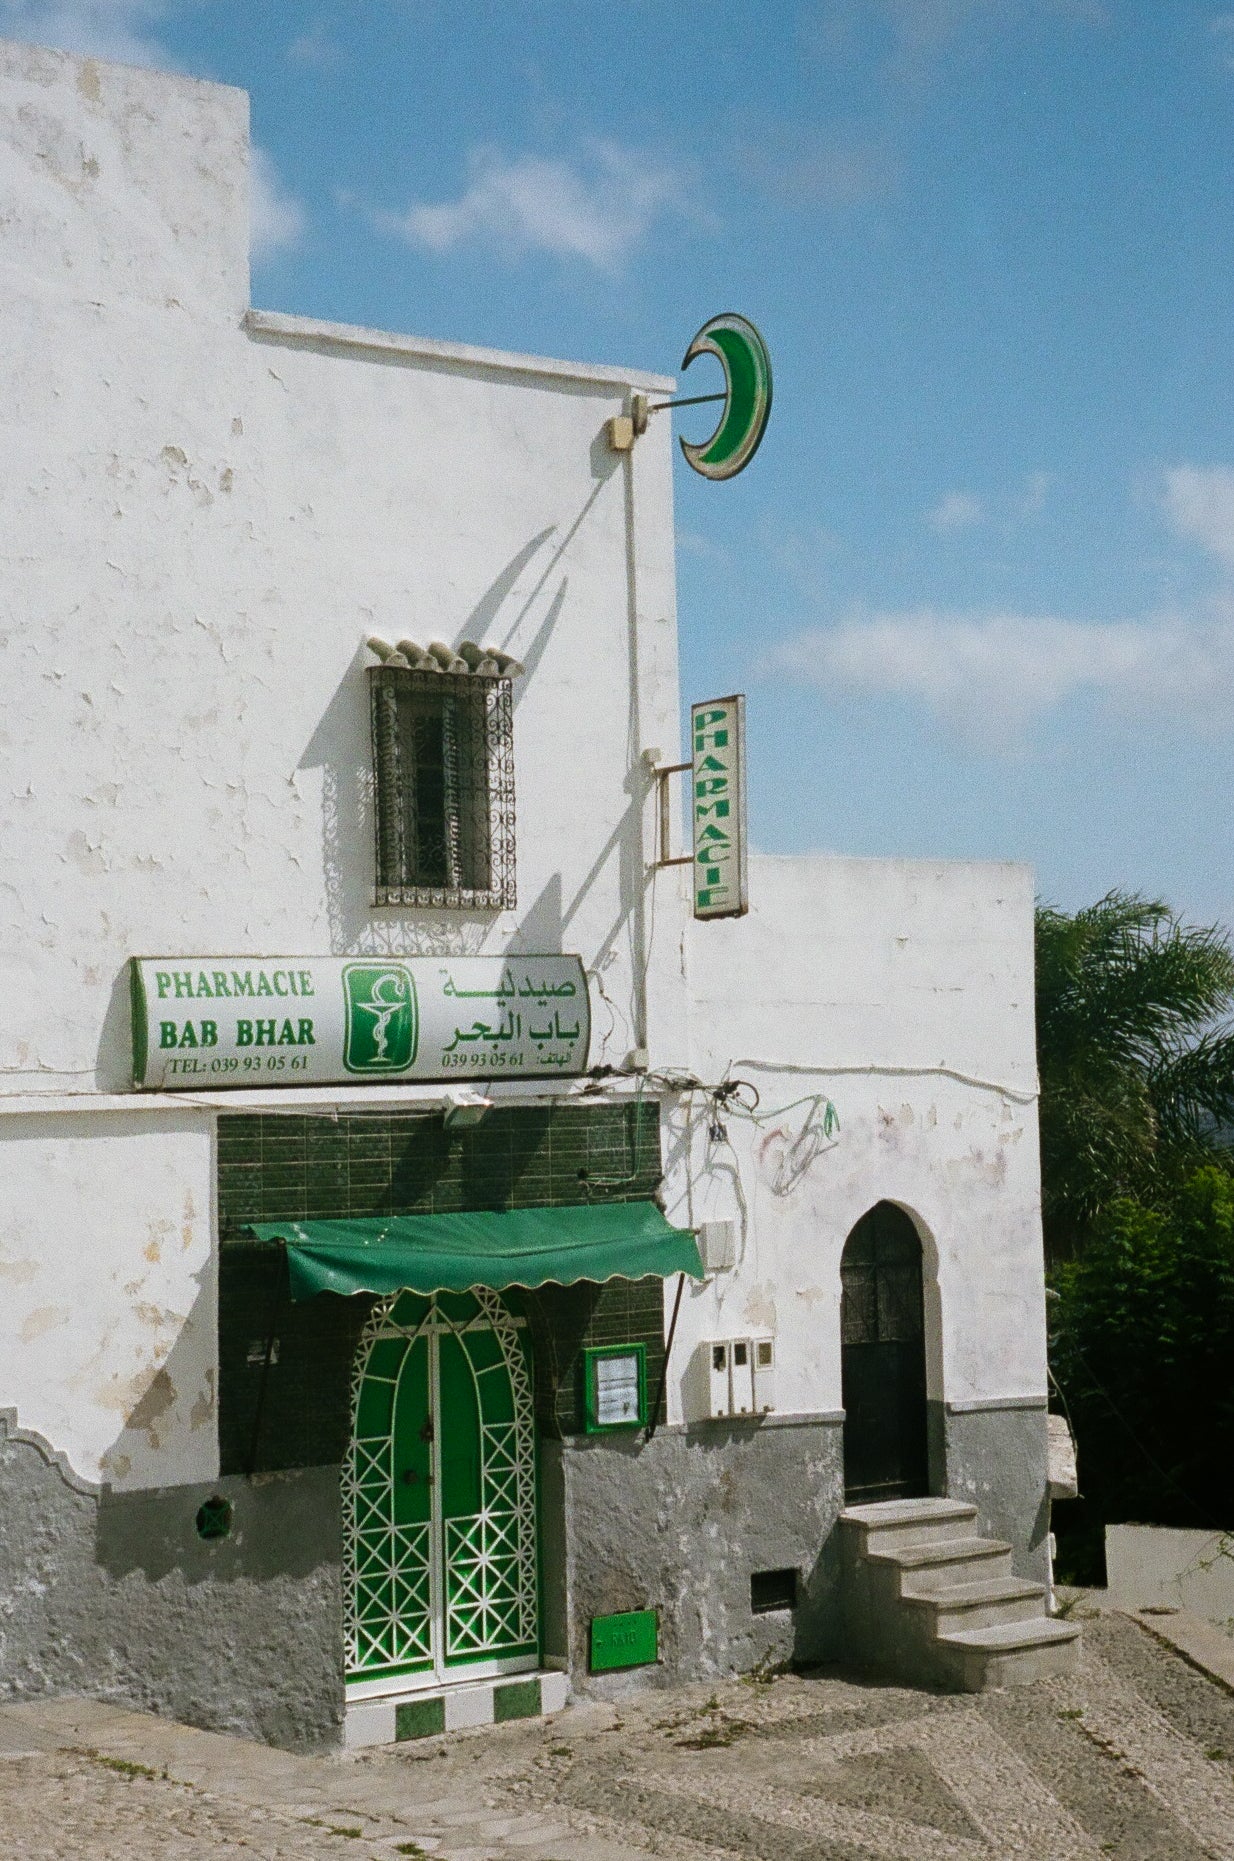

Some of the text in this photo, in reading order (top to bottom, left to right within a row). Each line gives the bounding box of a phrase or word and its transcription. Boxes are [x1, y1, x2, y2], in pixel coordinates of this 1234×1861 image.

[696, 710, 730, 908] PHARMACIE
[155, 970, 315, 998] PHARMACIE
[438, 968, 577, 1007] صيدلية
[159, 1018, 316, 1048] BAB BHAR
[442, 1010, 581, 1051] باب البحر
[169, 1055, 308, 1073] TEL: 039 93 05 61
[442, 1053, 467, 1067] 039
[471, 1053, 486, 1067] 93
[490, 1053, 507, 1067] 05
[510, 1053, 524, 1066] 61
